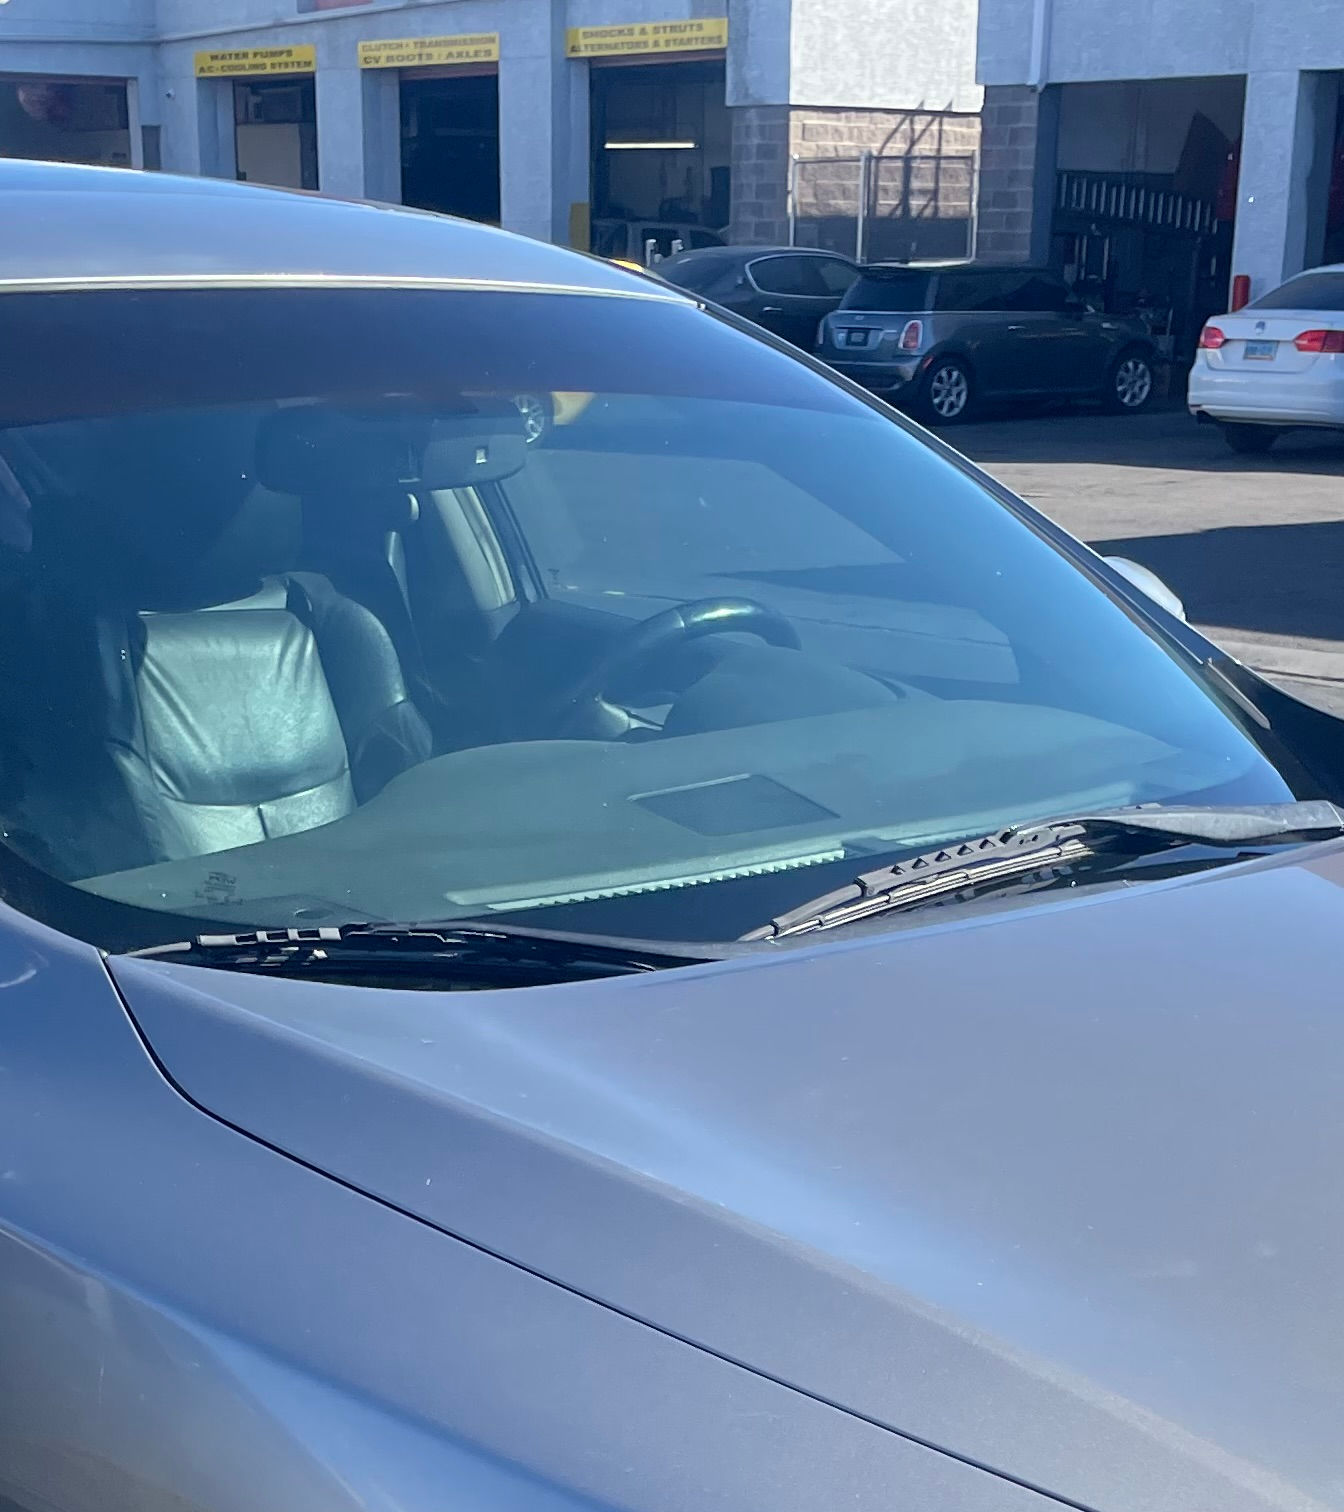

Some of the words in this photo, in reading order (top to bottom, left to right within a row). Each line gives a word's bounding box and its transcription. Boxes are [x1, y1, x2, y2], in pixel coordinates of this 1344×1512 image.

[652, 22, 703, 34] STRUTS
[210, 51, 249, 61] WATER
[253, 48, 293, 59] PUMPS
[270, 60, 312, 70] SYSTEM
